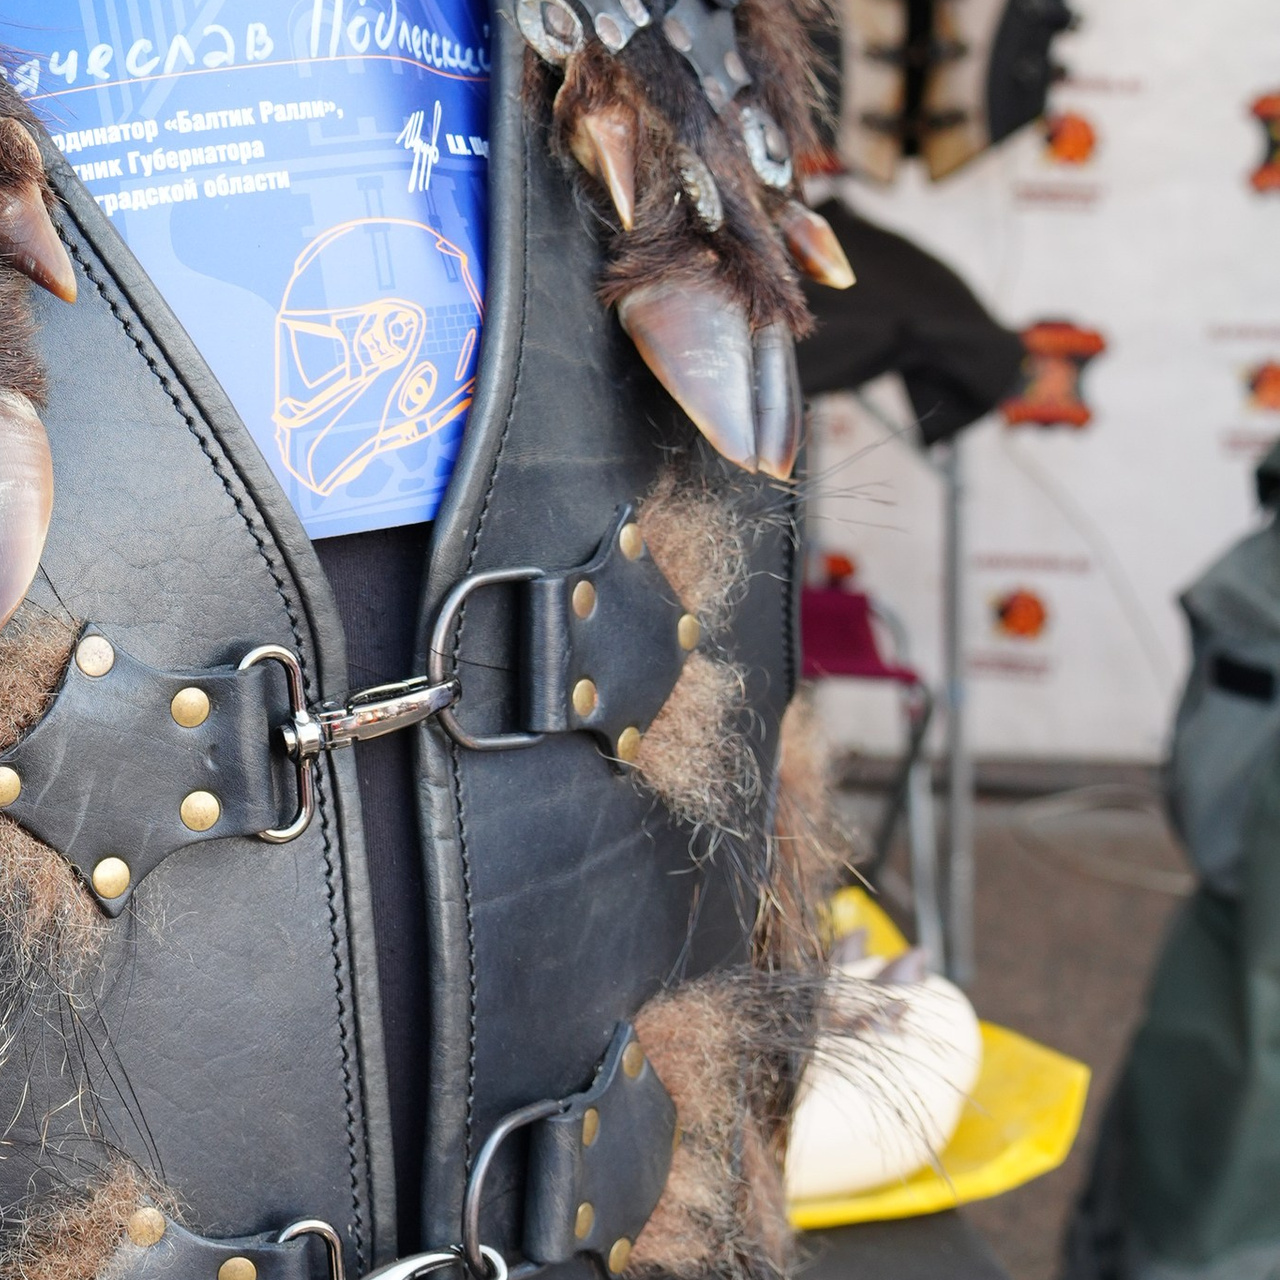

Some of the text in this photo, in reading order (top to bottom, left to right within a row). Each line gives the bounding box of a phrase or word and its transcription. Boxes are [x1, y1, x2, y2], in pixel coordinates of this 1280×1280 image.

[164, 106, 256, 134] «Балтик
[259, 99, 344, 124] Ралли»,
[127, 139, 265, 177] Губернатора
[203, 170, 291, 197] области
